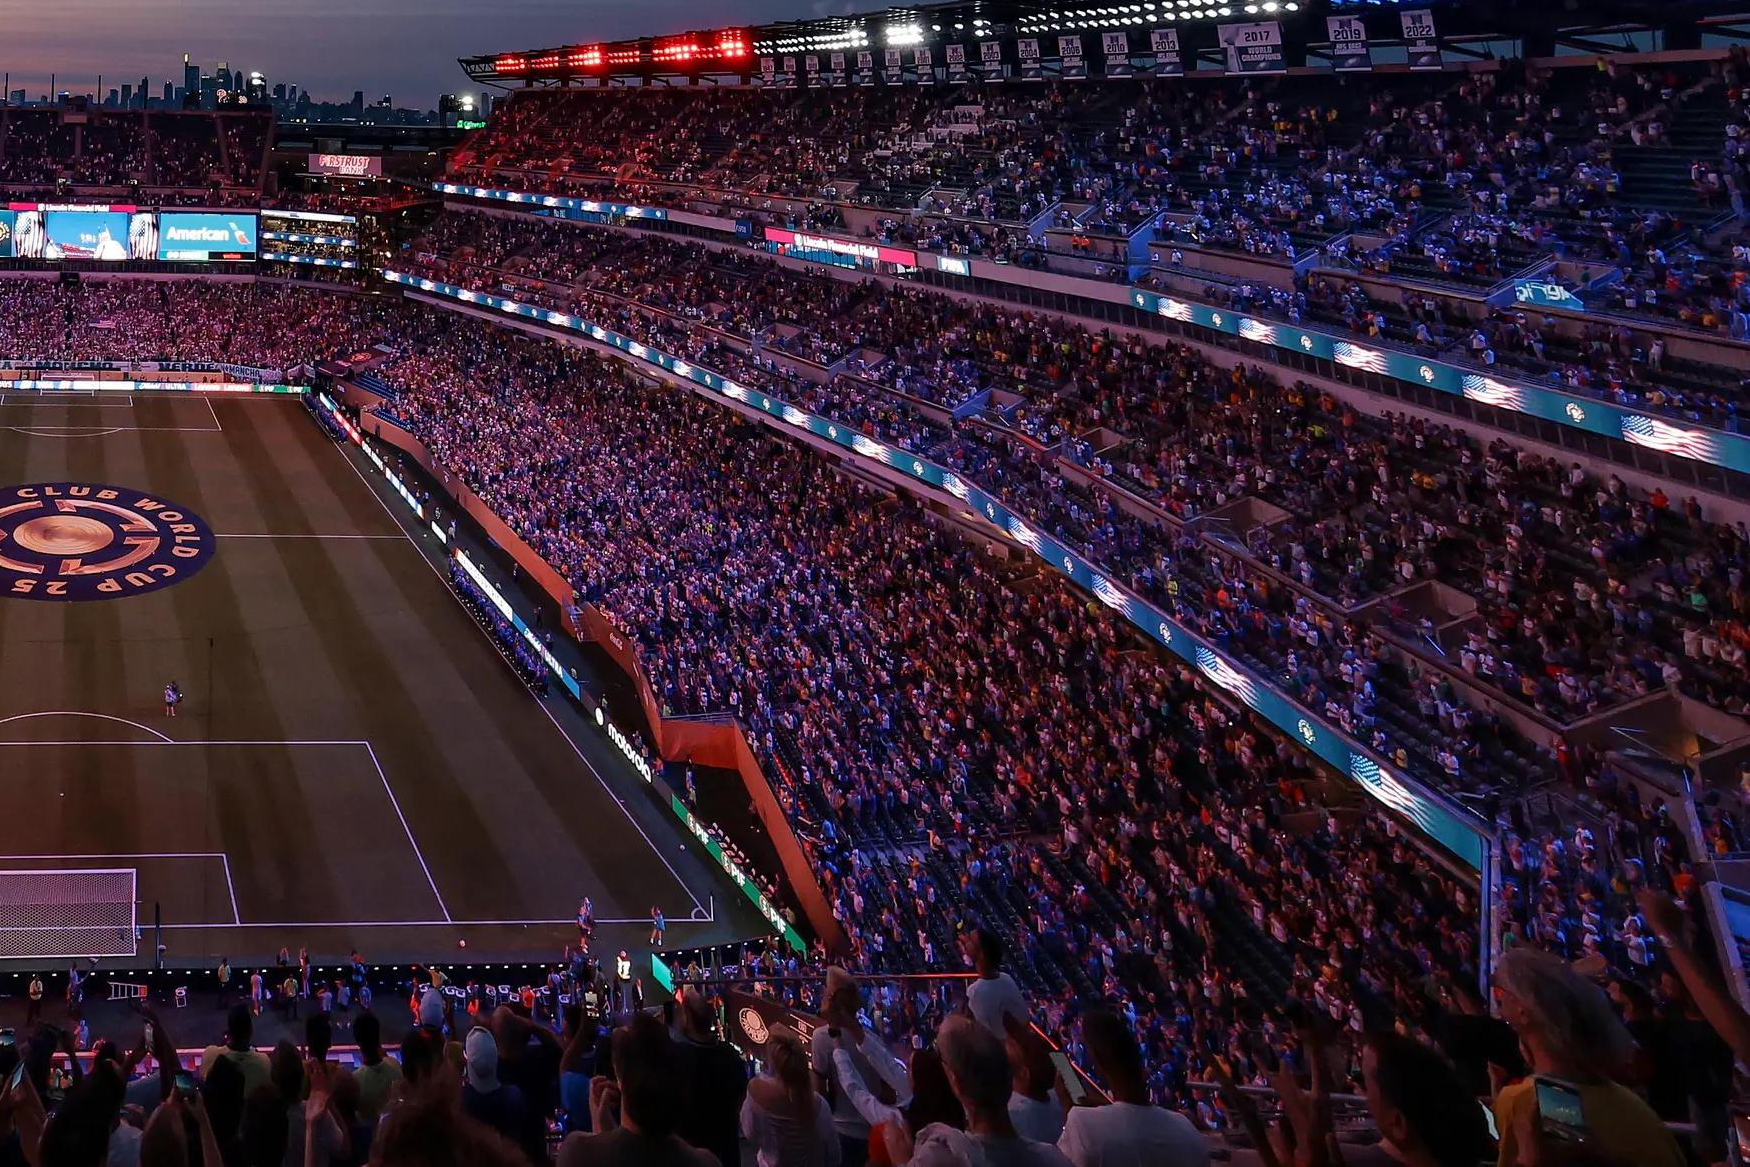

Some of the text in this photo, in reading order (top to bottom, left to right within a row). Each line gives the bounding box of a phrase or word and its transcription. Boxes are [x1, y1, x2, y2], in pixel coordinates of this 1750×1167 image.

[1244, 30, 1270, 42] 2017
[1333, 29, 1362, 40] 2019
[1405, 25, 1432, 37] 2022
[1107, 43, 1125, 53] 2010
[1155, 40, 1176, 50] 2013
[1248, 45, 1272, 55] WORLD
[1020, 49, 1038, 58] 2004
[166, 226, 229, 241] American
[803, 236, 879, 259] Lincoln Financial Field
[165, 382, 186, 390] ULTRA
[16, 486, 121, 500] CLUB
[133, 497, 201, 558] WORLD
[96, 563, 177, 593] CUP
[11, 578, 68, 595] 25
[607, 722, 652, 783] motorola
[695, 823, 709, 845] PIF
[730, 862, 746, 887] PIF
[770, 907, 786, 934] PIF
